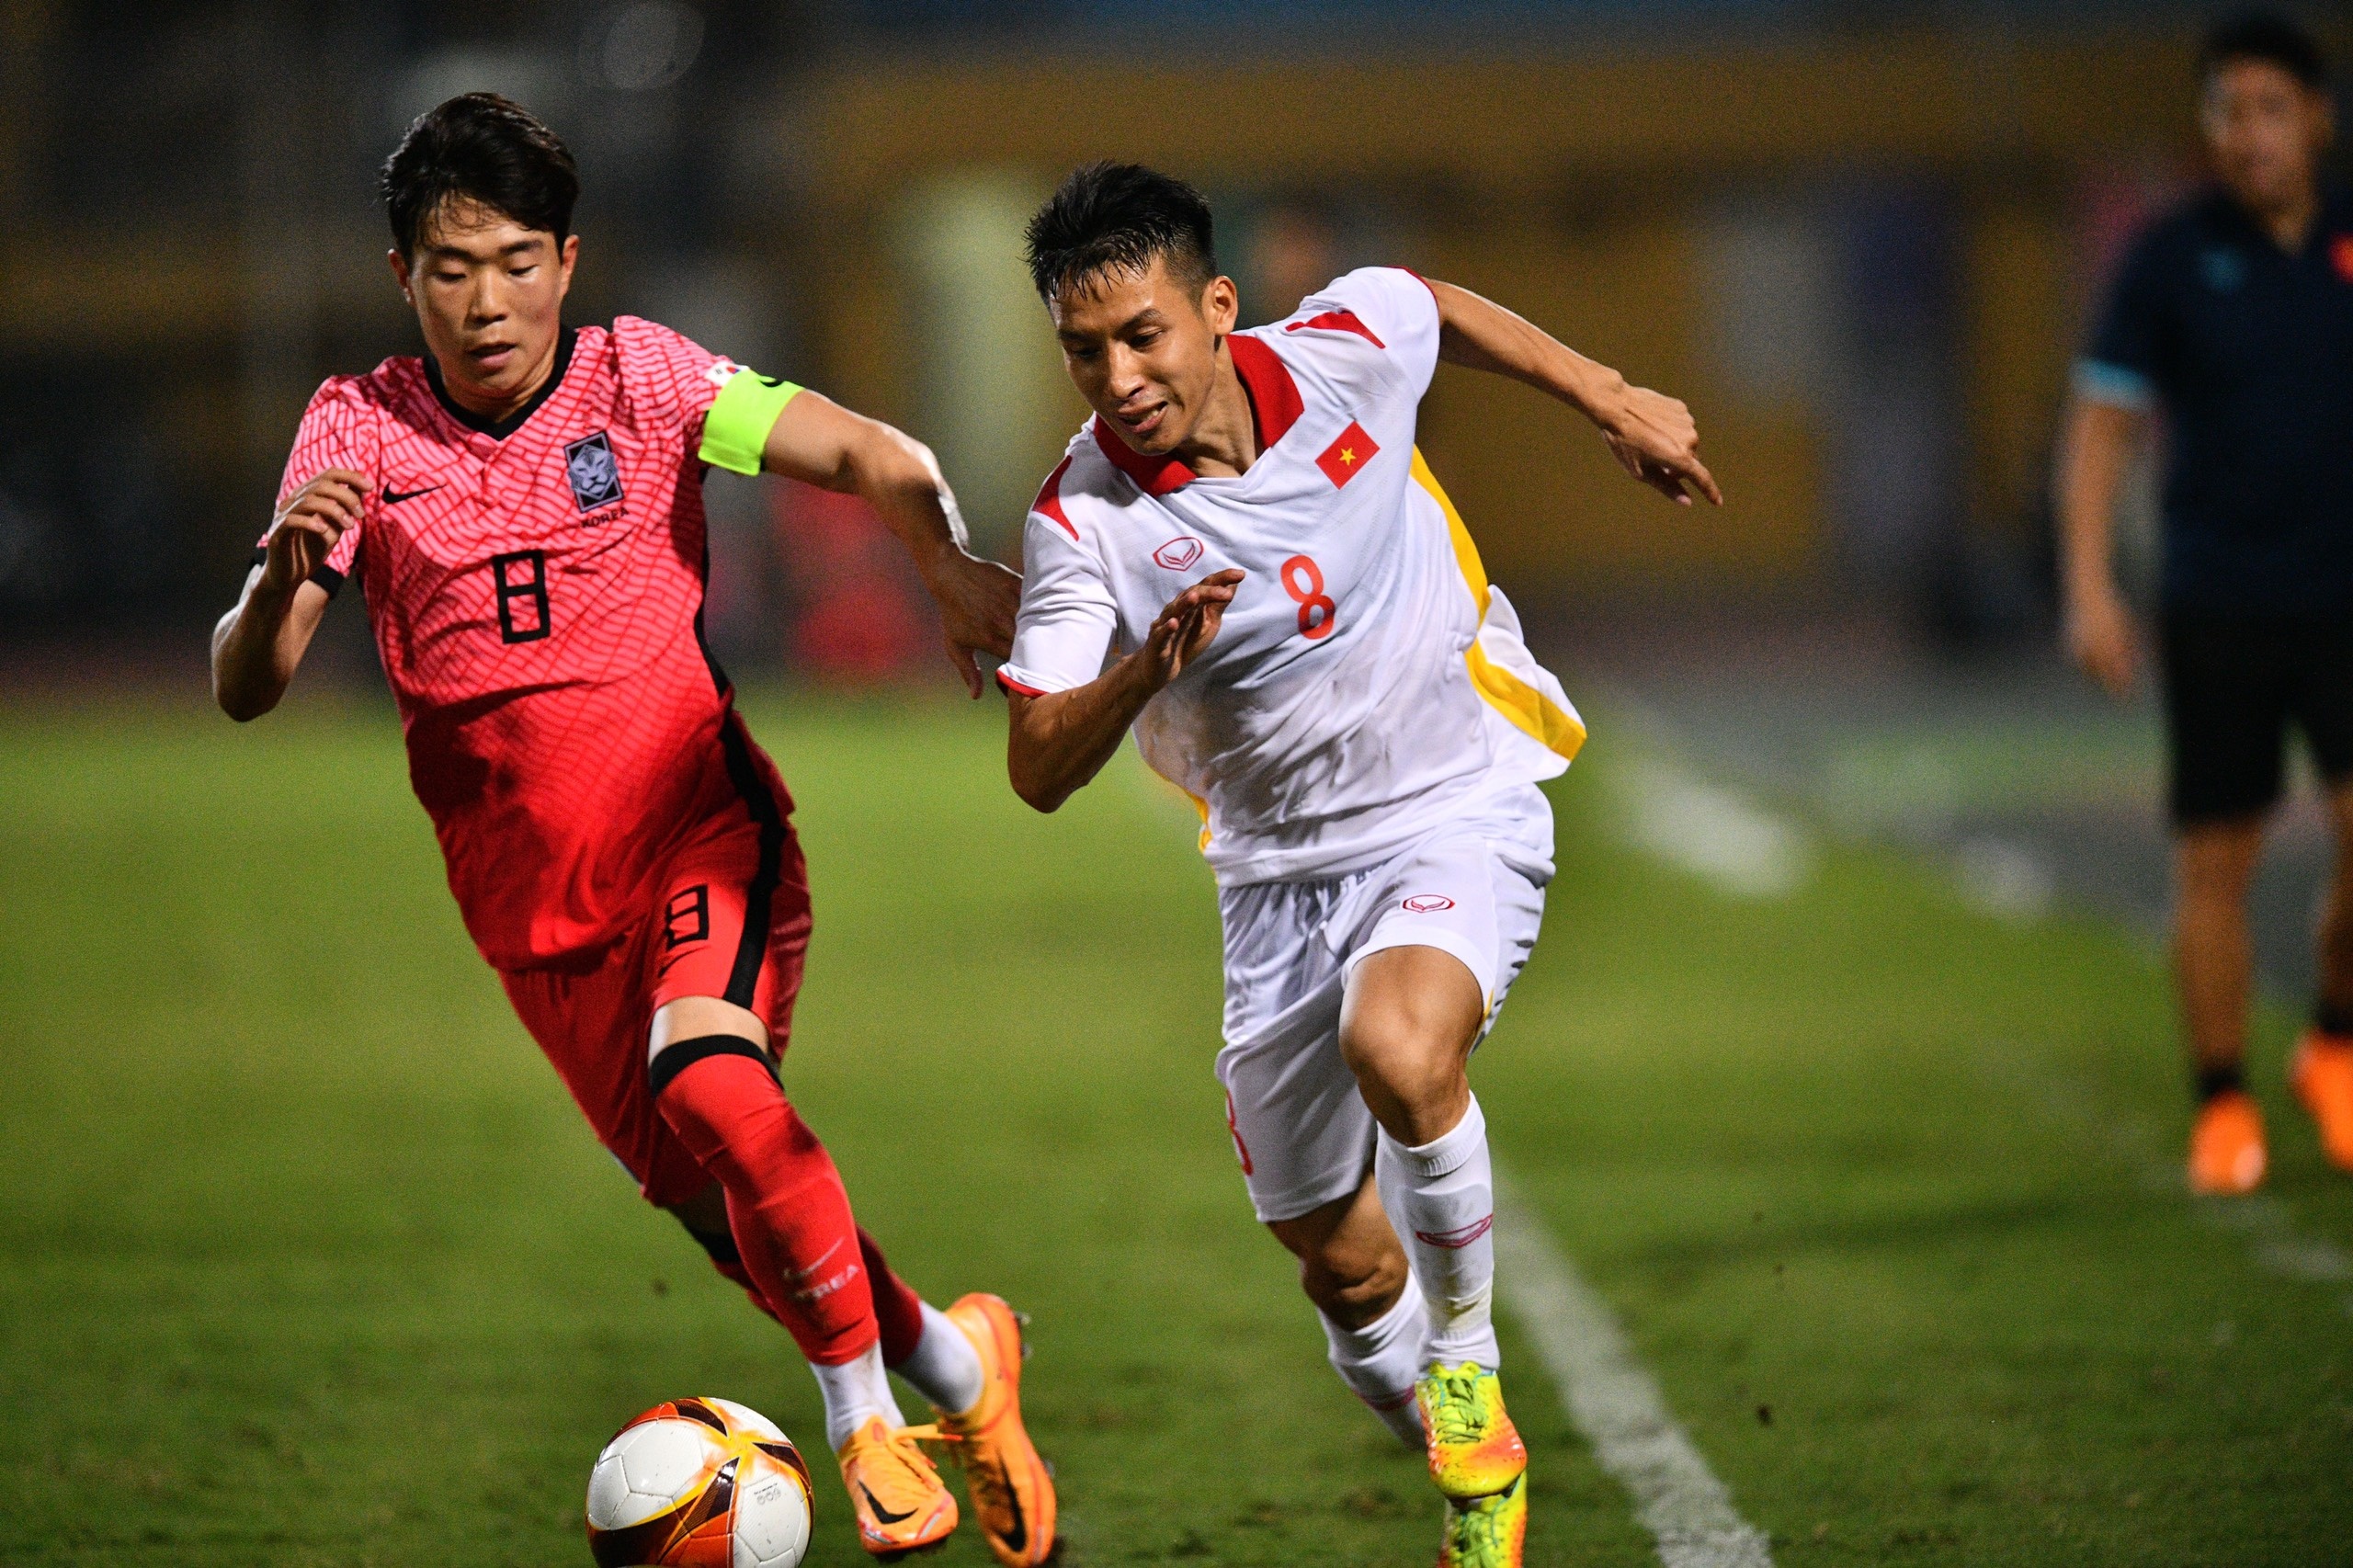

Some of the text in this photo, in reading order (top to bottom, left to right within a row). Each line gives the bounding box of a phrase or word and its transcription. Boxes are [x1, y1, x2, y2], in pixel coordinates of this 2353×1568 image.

[581, 506, 630, 528] KOREA
[493, 550, 551, 644] 8
[1280, 554, 1336, 640] 8
[664, 882, 709, 953] 8
